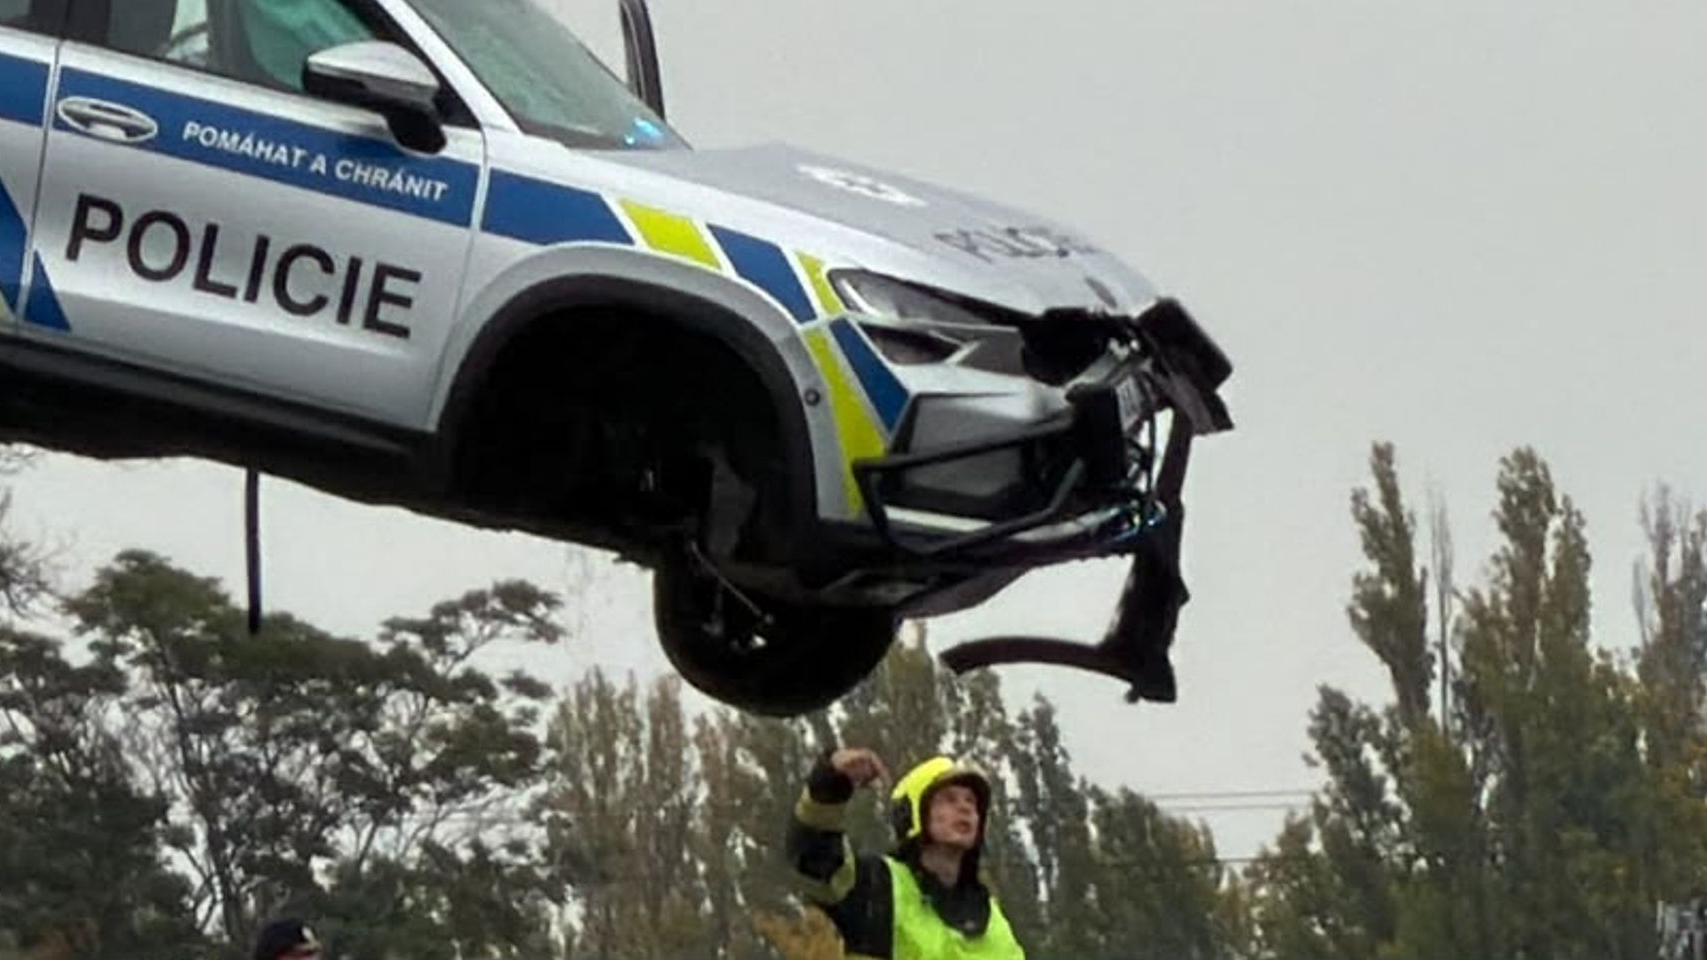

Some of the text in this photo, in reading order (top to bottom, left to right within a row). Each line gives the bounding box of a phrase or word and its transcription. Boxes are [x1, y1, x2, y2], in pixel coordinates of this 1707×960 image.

[182, 121, 449, 202] POMÁHAT A CHRÁNIT
[65, 193, 422, 339] POLICIE
